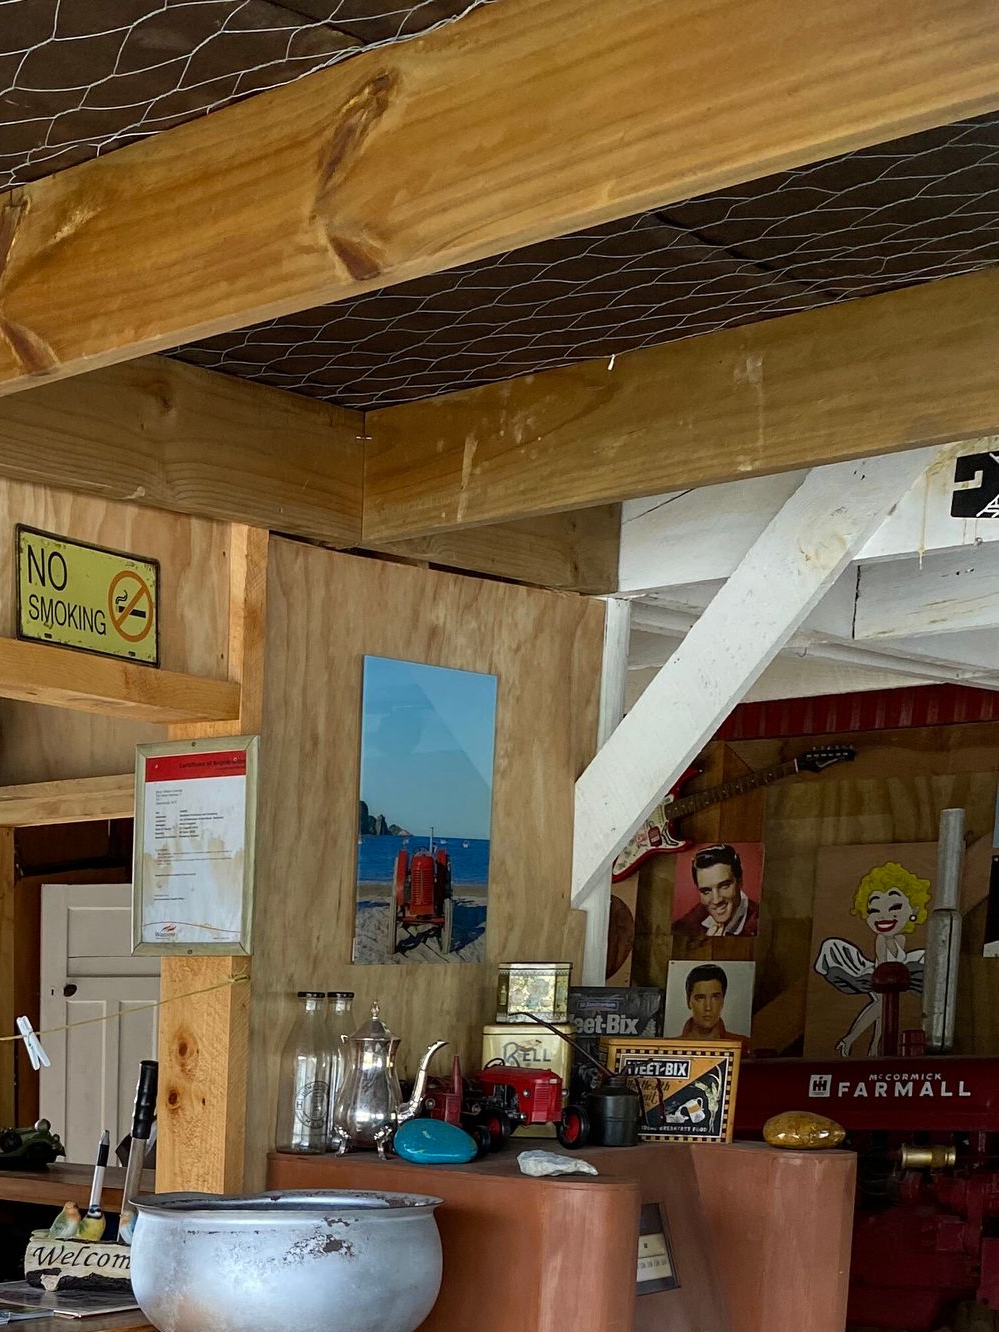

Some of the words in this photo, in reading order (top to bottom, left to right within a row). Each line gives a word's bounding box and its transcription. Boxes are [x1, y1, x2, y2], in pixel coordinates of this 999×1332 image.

[27, 544, 68, 591] NO
[28, 593, 107, 635] SMOKING
[570, 1013, 639, 1035] eet-Bix
[641, 1079, 671, 1092] Heath
[837, 1081, 972, 1098] FARMALL
[32, 1245, 130, 1269] Welcom
